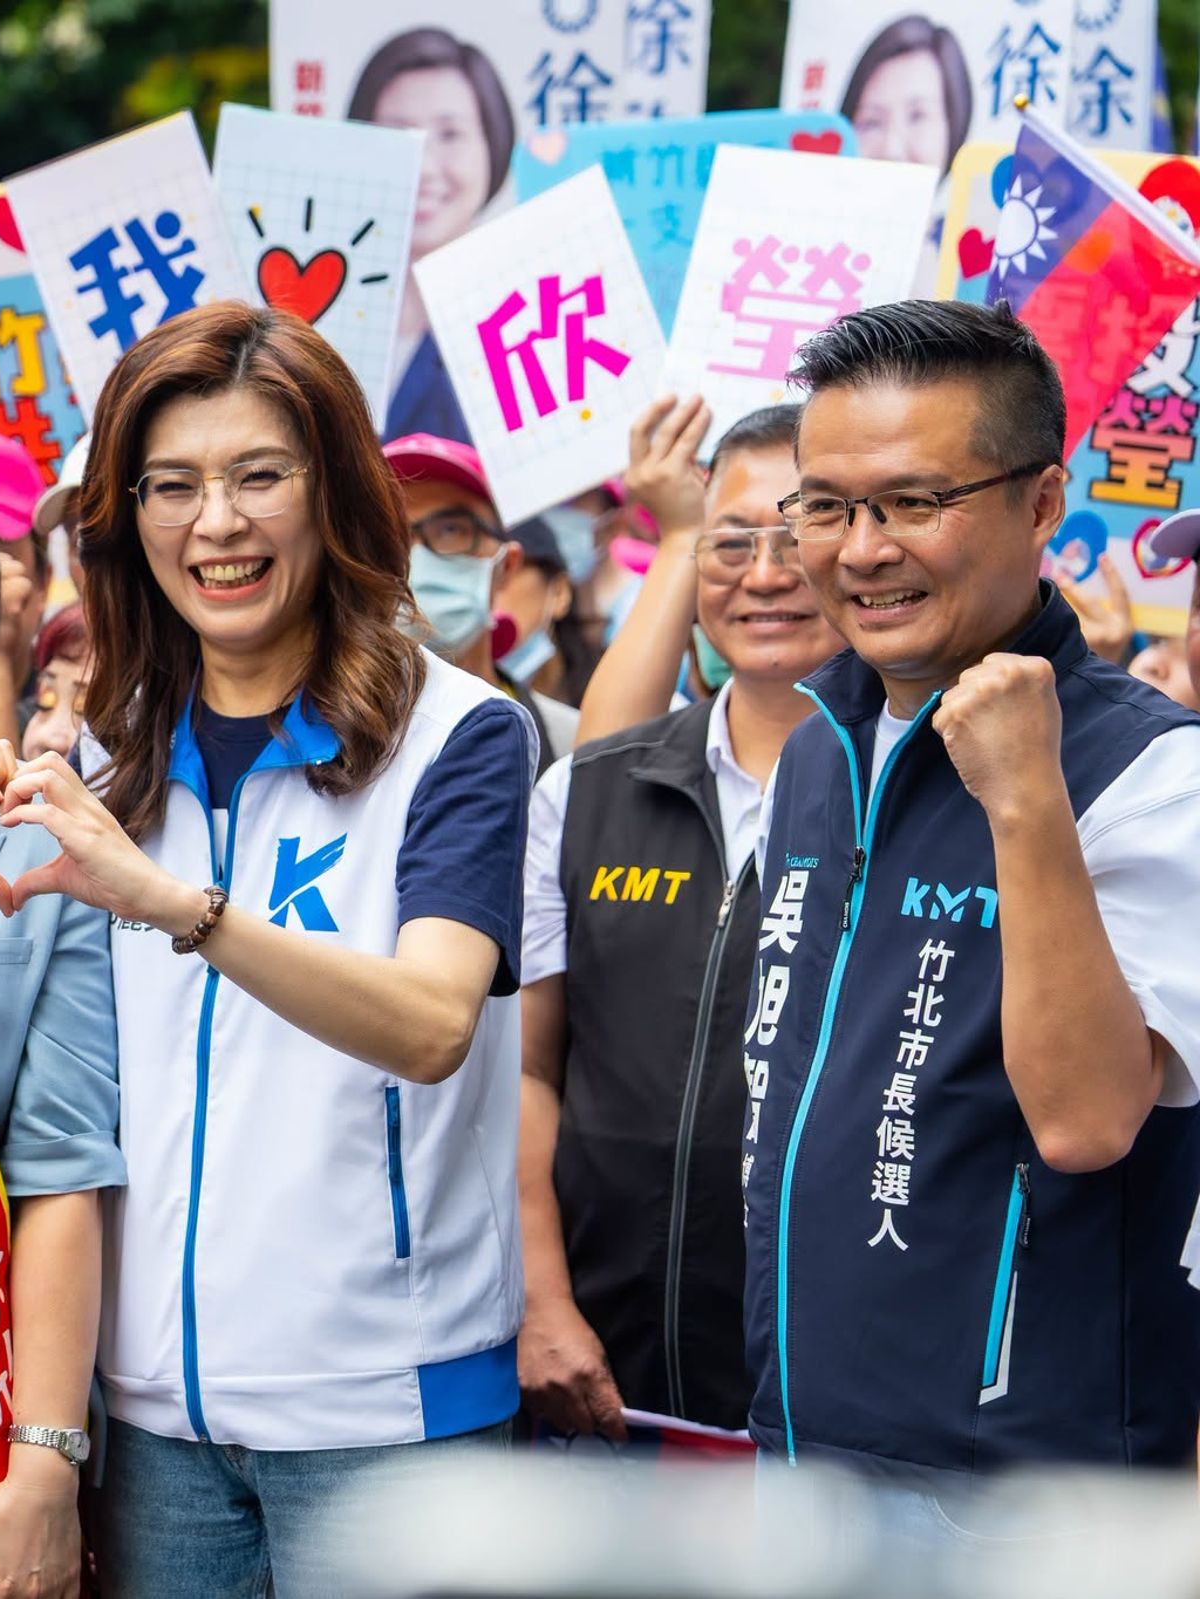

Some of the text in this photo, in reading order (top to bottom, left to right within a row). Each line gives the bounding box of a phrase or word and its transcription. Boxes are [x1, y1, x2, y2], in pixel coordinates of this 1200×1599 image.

[68, 211, 206, 354] 我
[477, 274, 632, 432] 欣
[269, 832, 348, 933] K
[589, 866, 691, 904] KMT
[900, 877, 998, 929] KMT
[866, 938, 955, 1252] 竹北市長候選人
